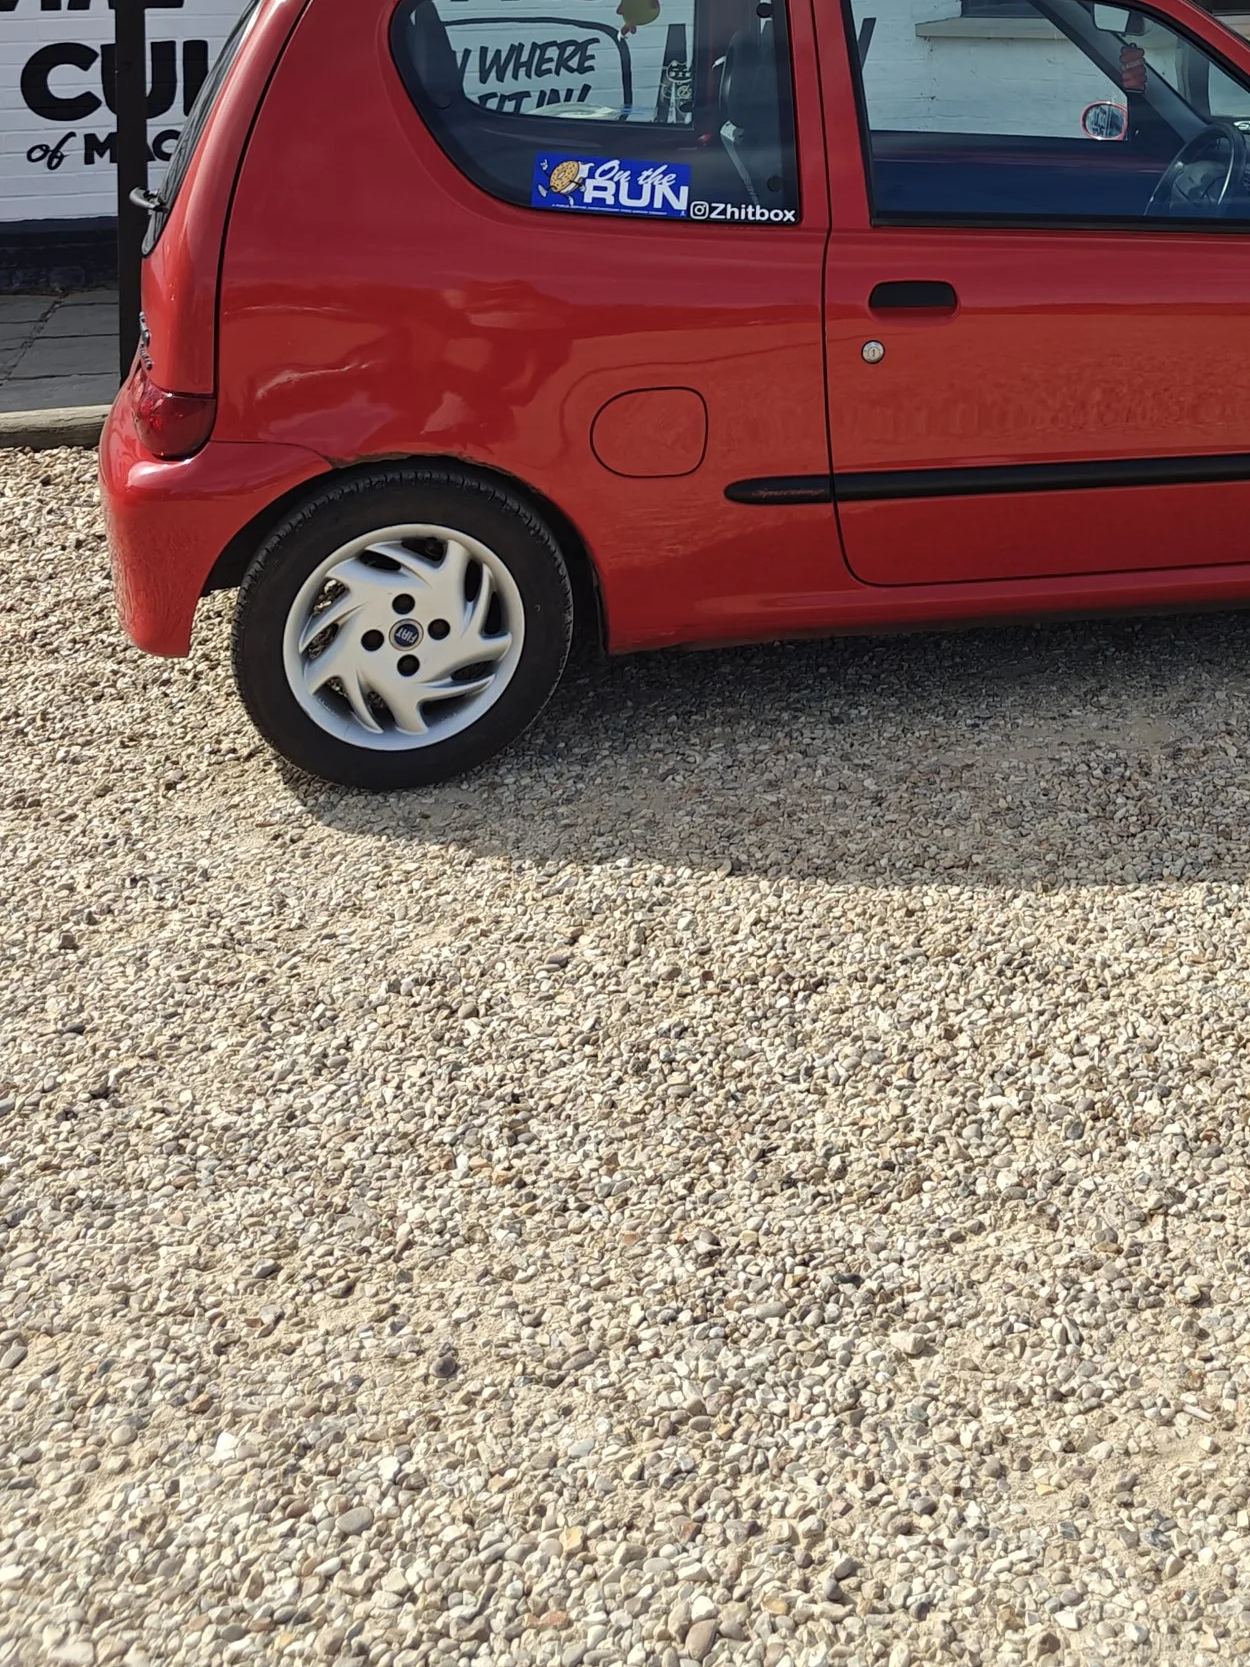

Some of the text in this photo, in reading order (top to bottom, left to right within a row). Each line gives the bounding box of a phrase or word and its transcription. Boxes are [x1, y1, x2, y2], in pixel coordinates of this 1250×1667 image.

[478, 37, 601, 85] WHERE
[26, 131, 76, 171] of
[594, 159, 677, 185] On the
[583, 178, 689, 211] RUN
[395, 627, 418, 644] FIAT
